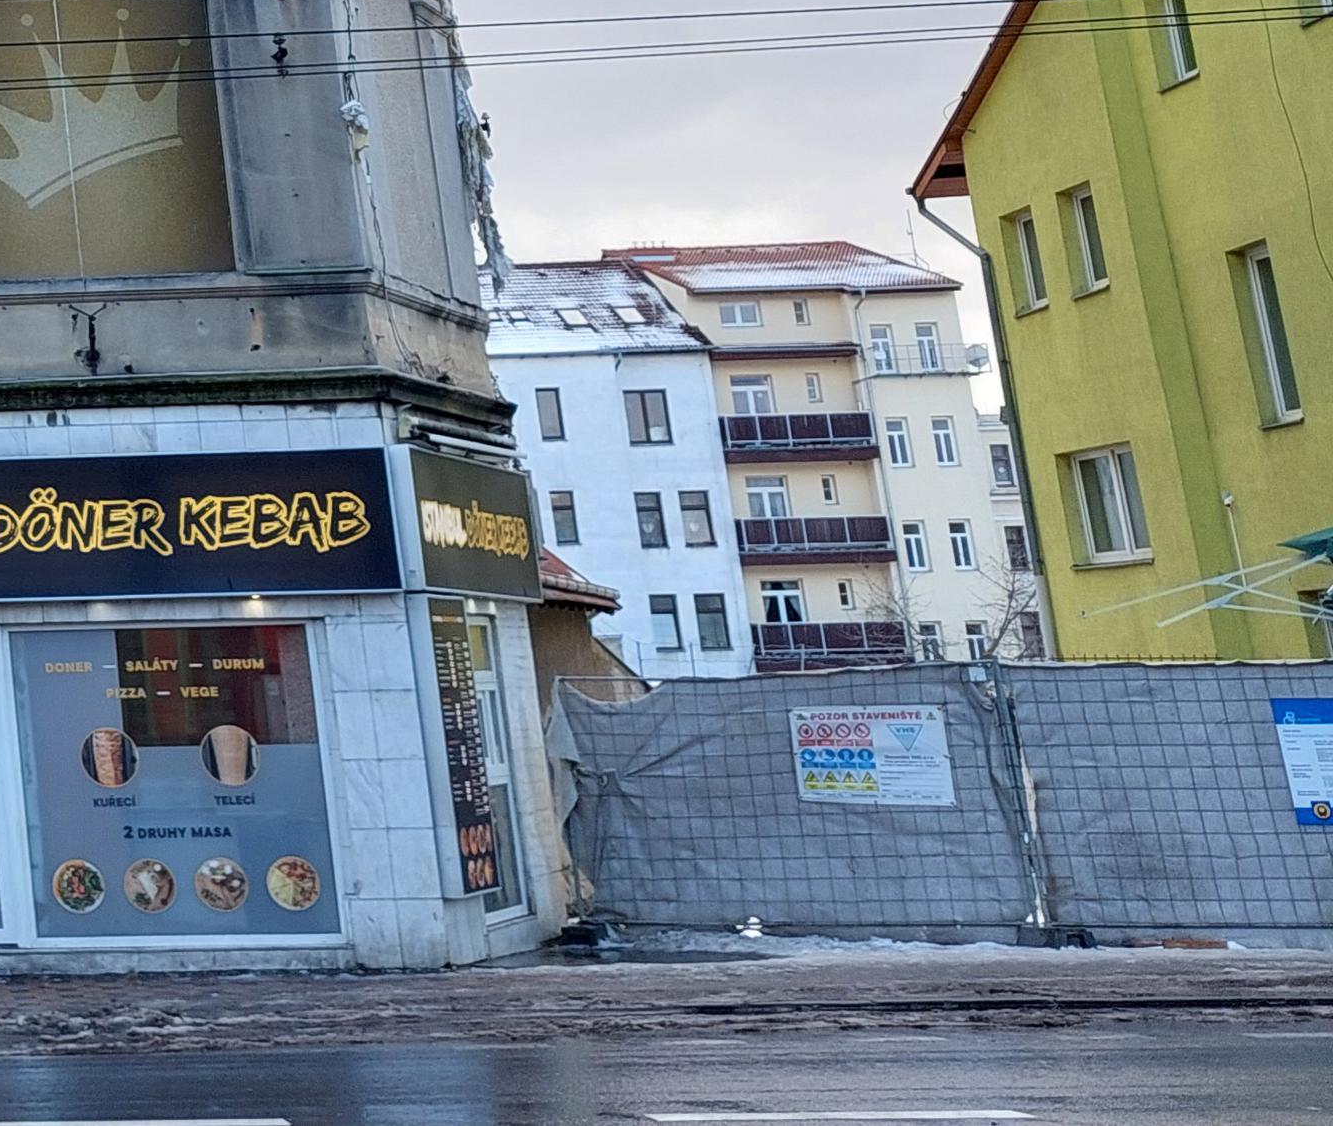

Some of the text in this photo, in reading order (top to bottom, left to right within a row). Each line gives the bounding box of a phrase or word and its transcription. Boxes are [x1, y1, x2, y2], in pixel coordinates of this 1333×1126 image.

[179, 490, 372, 554] KEBAB
[43, 661, 94, 674] DONER
[124, 656, 180, 672] SALÁTY
[105, 686, 220, 700] PIZZA VEGE
[92, 791, 256, 809] KUŘECÍ TELECÍ
[122, 825, 233, 840] 2 DRUHY MASA
